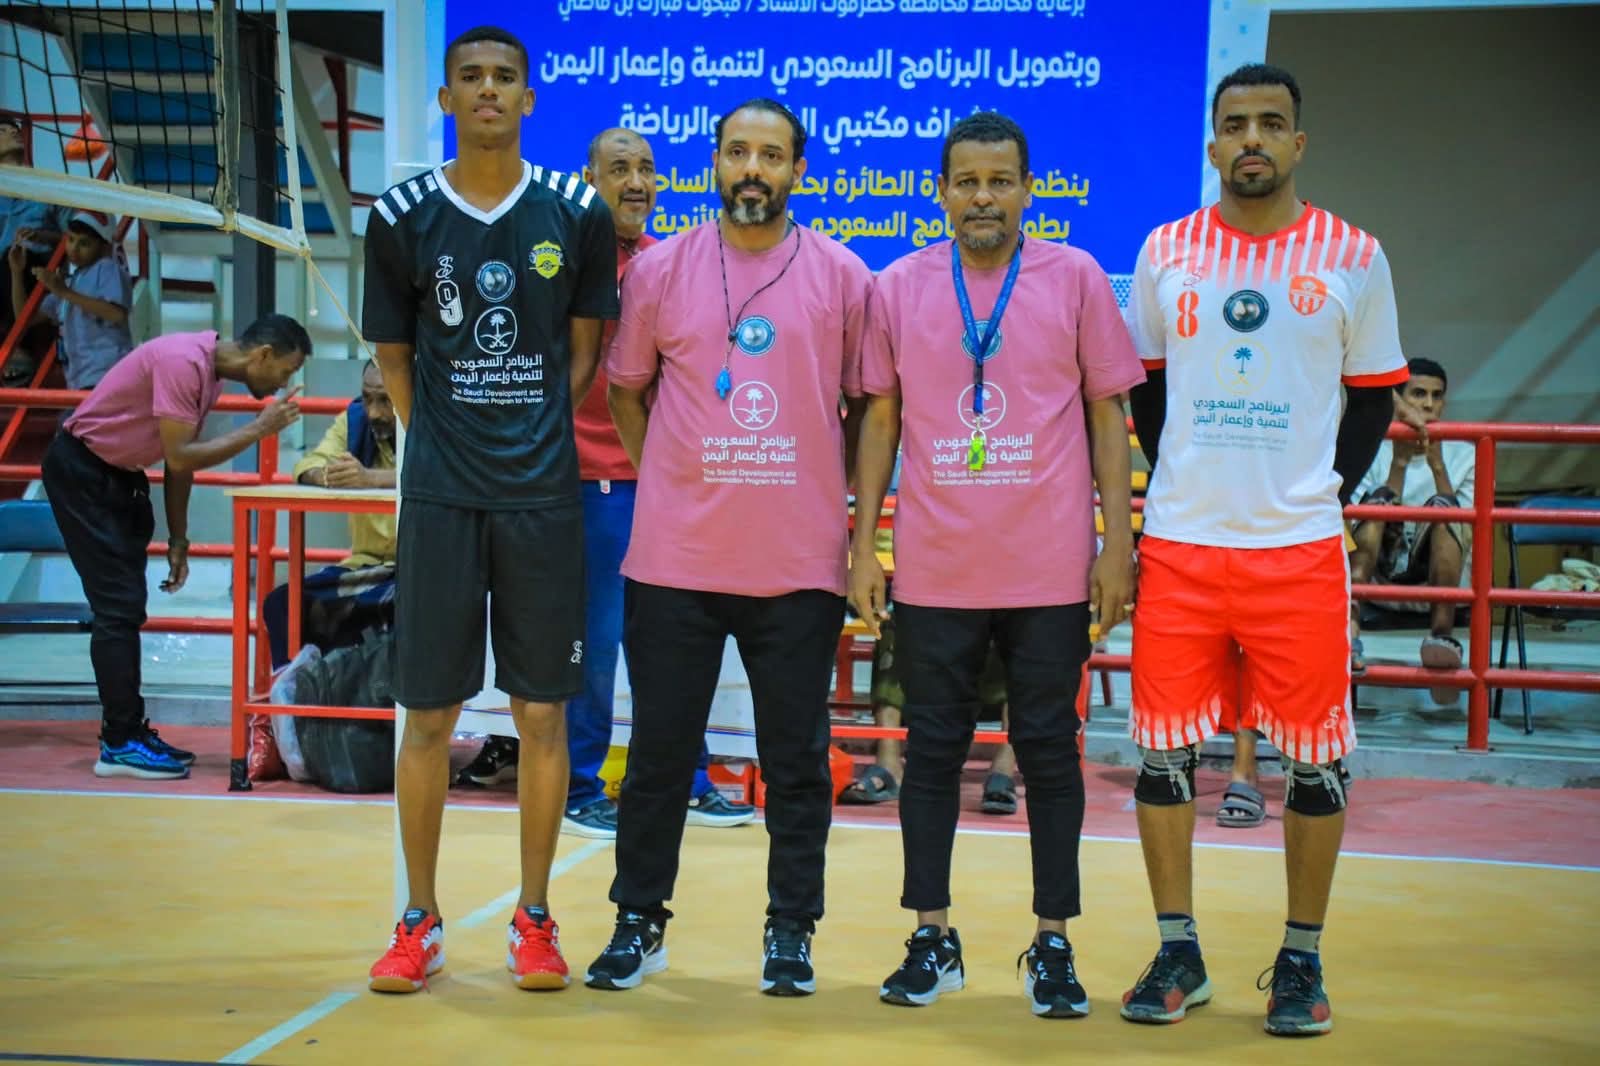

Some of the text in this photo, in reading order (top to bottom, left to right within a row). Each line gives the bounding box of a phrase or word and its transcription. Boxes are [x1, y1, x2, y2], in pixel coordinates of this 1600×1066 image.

[540, 46, 1101, 95] وبتمويل البرنامج السعودي لتنمية وإعمار اليمن
[823, 105, 910, 154] مكتبي
[833, 166, 915, 203] الطائرة
[1176, 290, 1200, 338] 8
[450, 354, 543, 371] البرنامج السعودي
[450, 369, 543, 385] لتنمية وإعمار اليمن
[1193, 399, 1290, 415] البرنامج السعودي
[702, 434, 796, 449] البرنامج السعودي
[991, 433, 1033, 449] البرنامج
[702, 450, 729, 463] اليمن
[732, 450, 767, 464] وإعمار
[932, 451, 960, 464] اليمن
